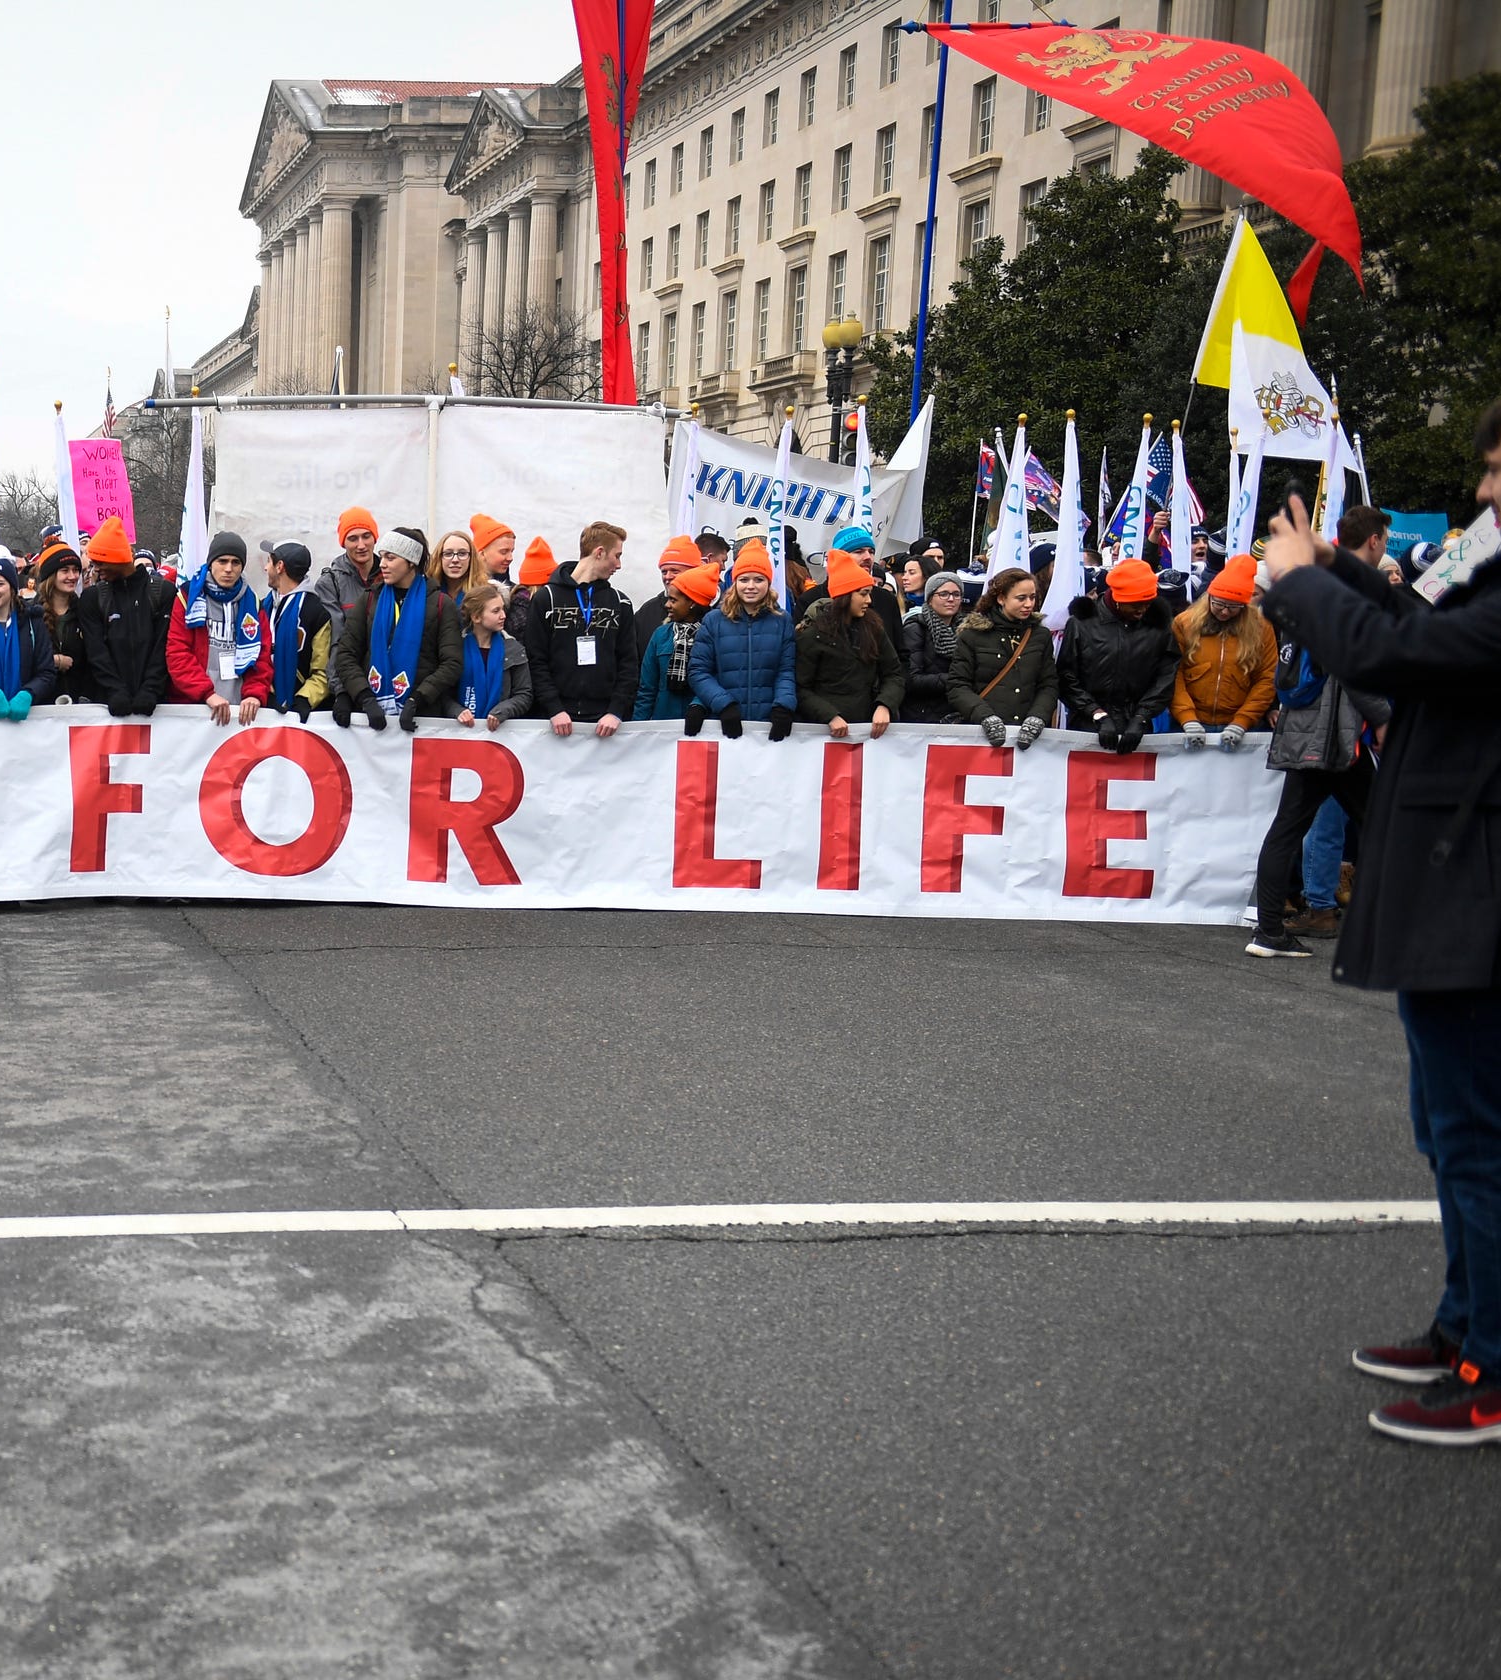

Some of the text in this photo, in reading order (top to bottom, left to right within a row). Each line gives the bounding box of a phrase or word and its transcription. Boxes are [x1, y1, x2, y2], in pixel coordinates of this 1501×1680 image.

[1163, 67, 1254, 114] Family
[95, 479, 119, 490] RIGHT
[96, 493, 104, 502] to
[69, 724, 525, 886] FOR
[672, 740, 1158, 899] LIFE
